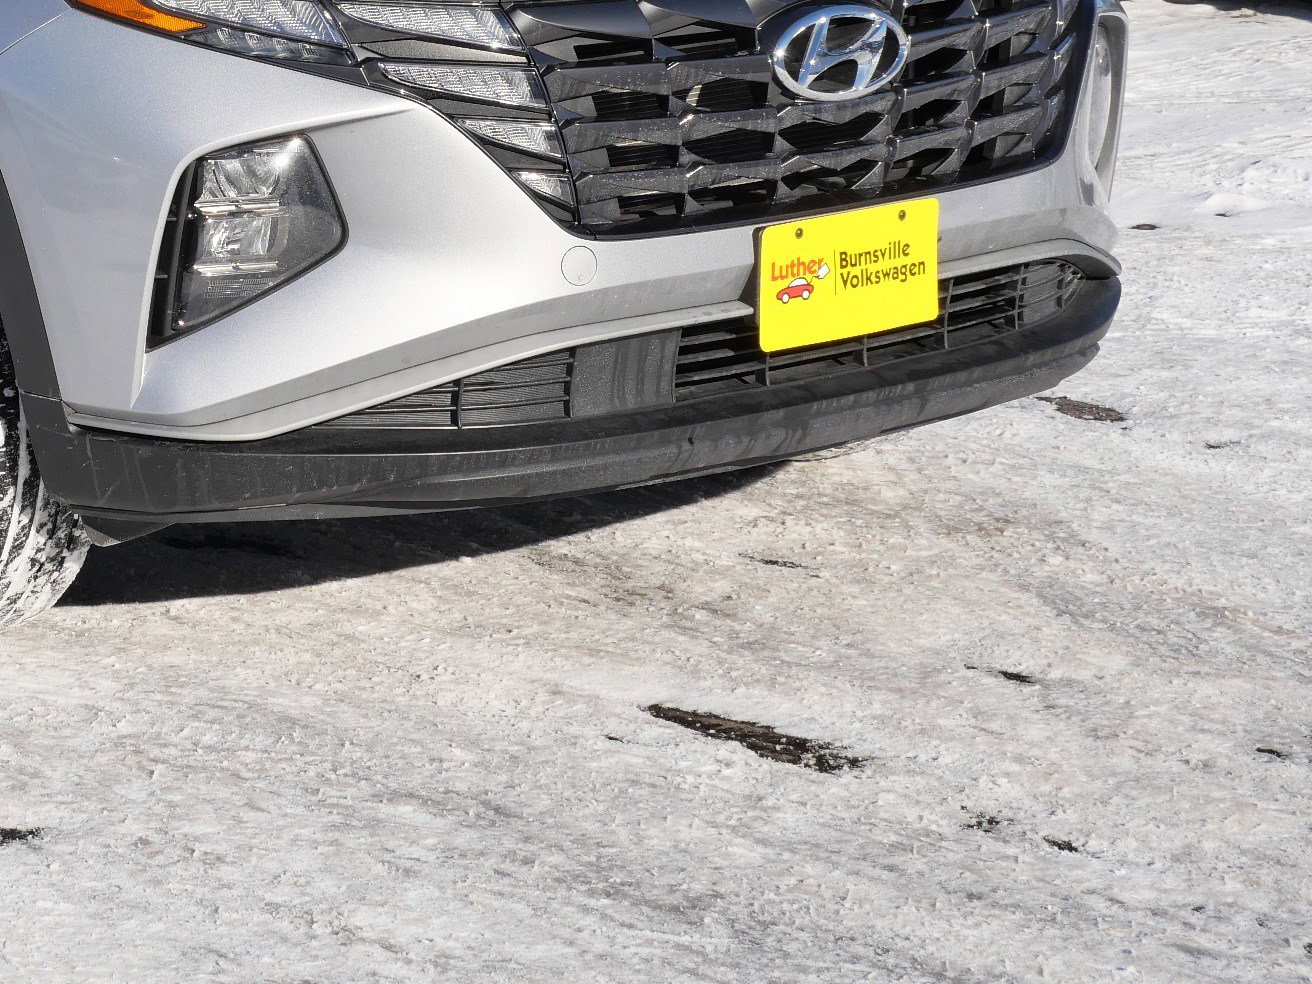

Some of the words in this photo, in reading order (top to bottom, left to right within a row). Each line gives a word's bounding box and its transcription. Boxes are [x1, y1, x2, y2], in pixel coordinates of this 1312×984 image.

[771, 256, 824, 281] Luther
[839, 240, 911, 269] Burnsville
[839, 260, 926, 291] Volkswagen
